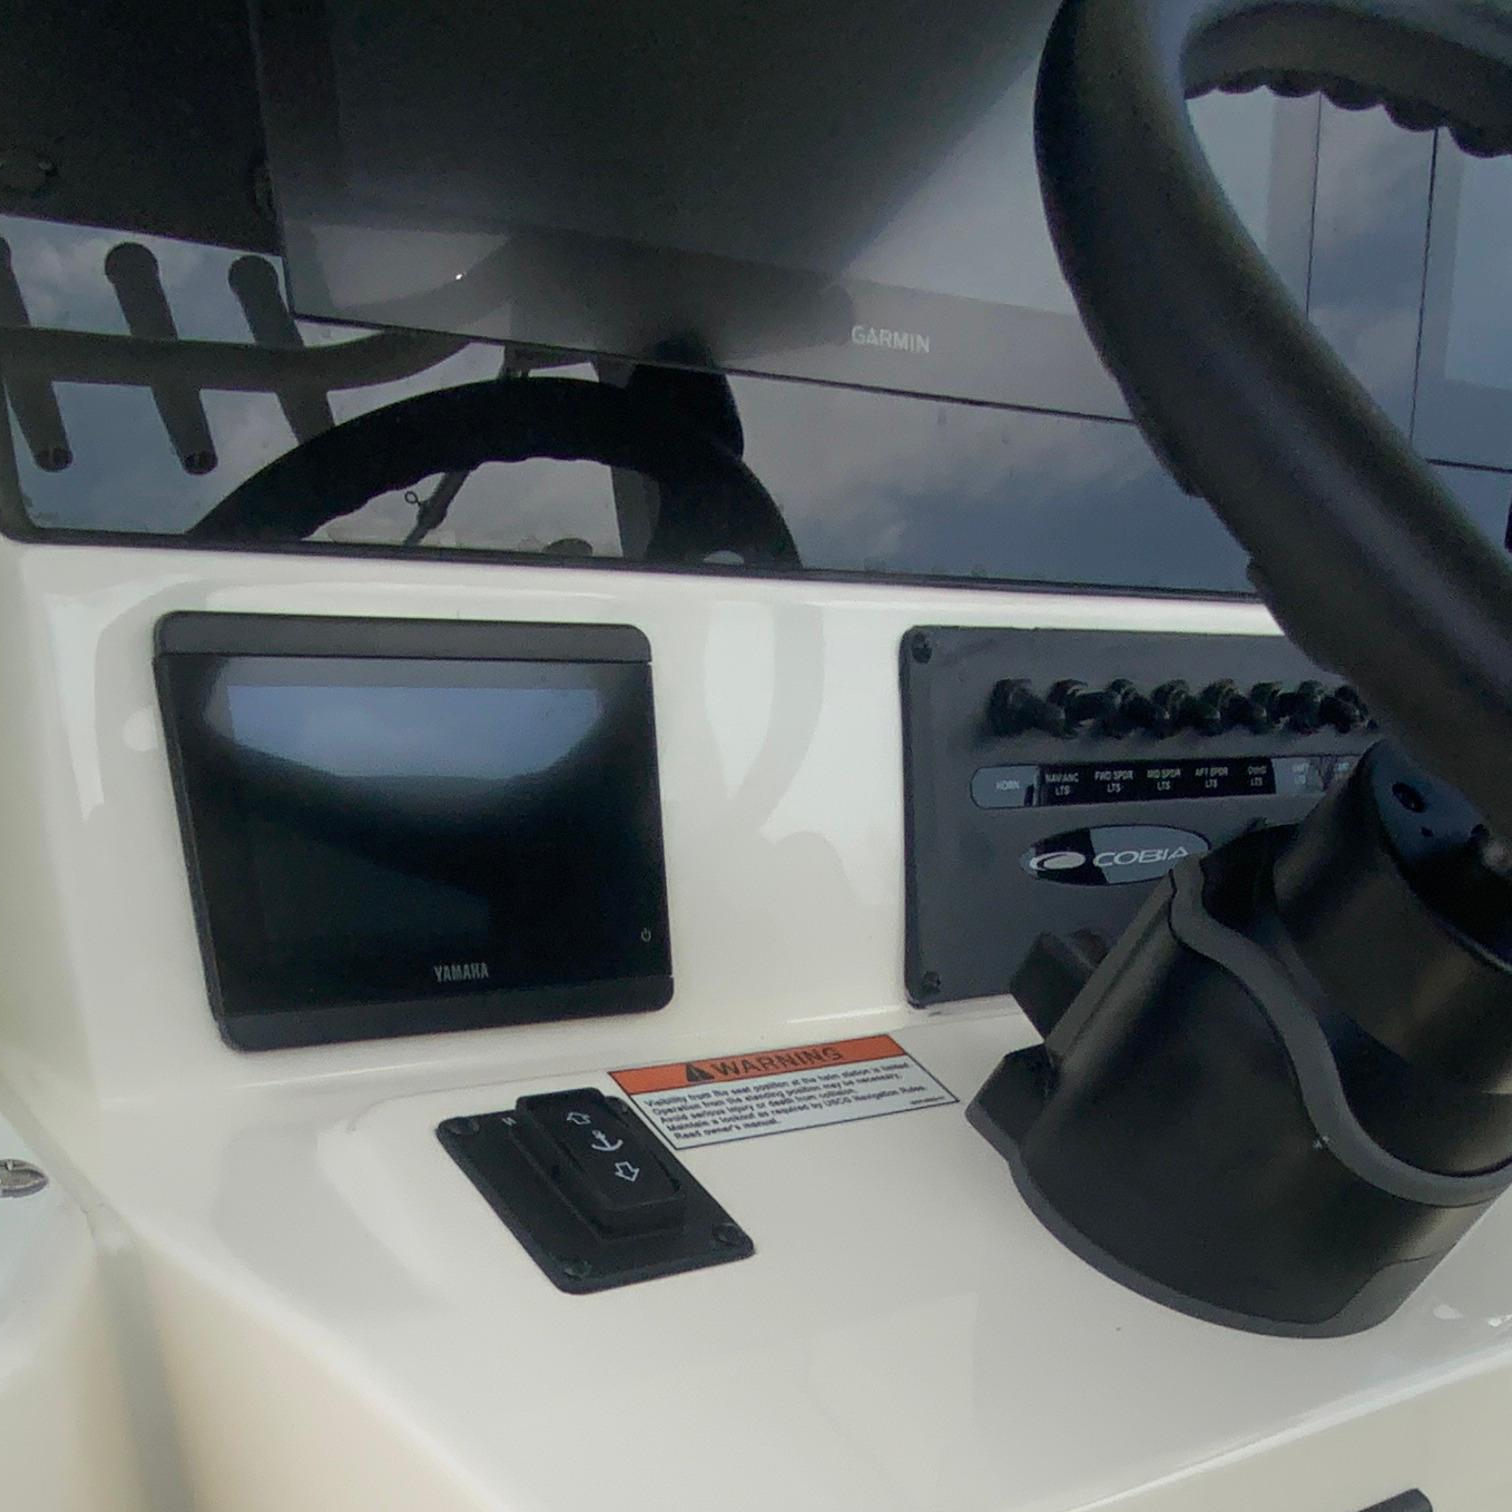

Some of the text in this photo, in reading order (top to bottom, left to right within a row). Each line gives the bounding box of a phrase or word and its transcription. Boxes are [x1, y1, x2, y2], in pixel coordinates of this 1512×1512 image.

[851, 325, 931, 353] GARMIN
[1106, 783, 1121, 793] LTS
[1156, 780, 1171, 791] LTS
[1204, 779, 1218, 789] LTS
[1092, 846, 1188, 867] COBIA
[432, 962, 489, 983] YAMAHA
[710, 1046, 842, 1077] WARNING
